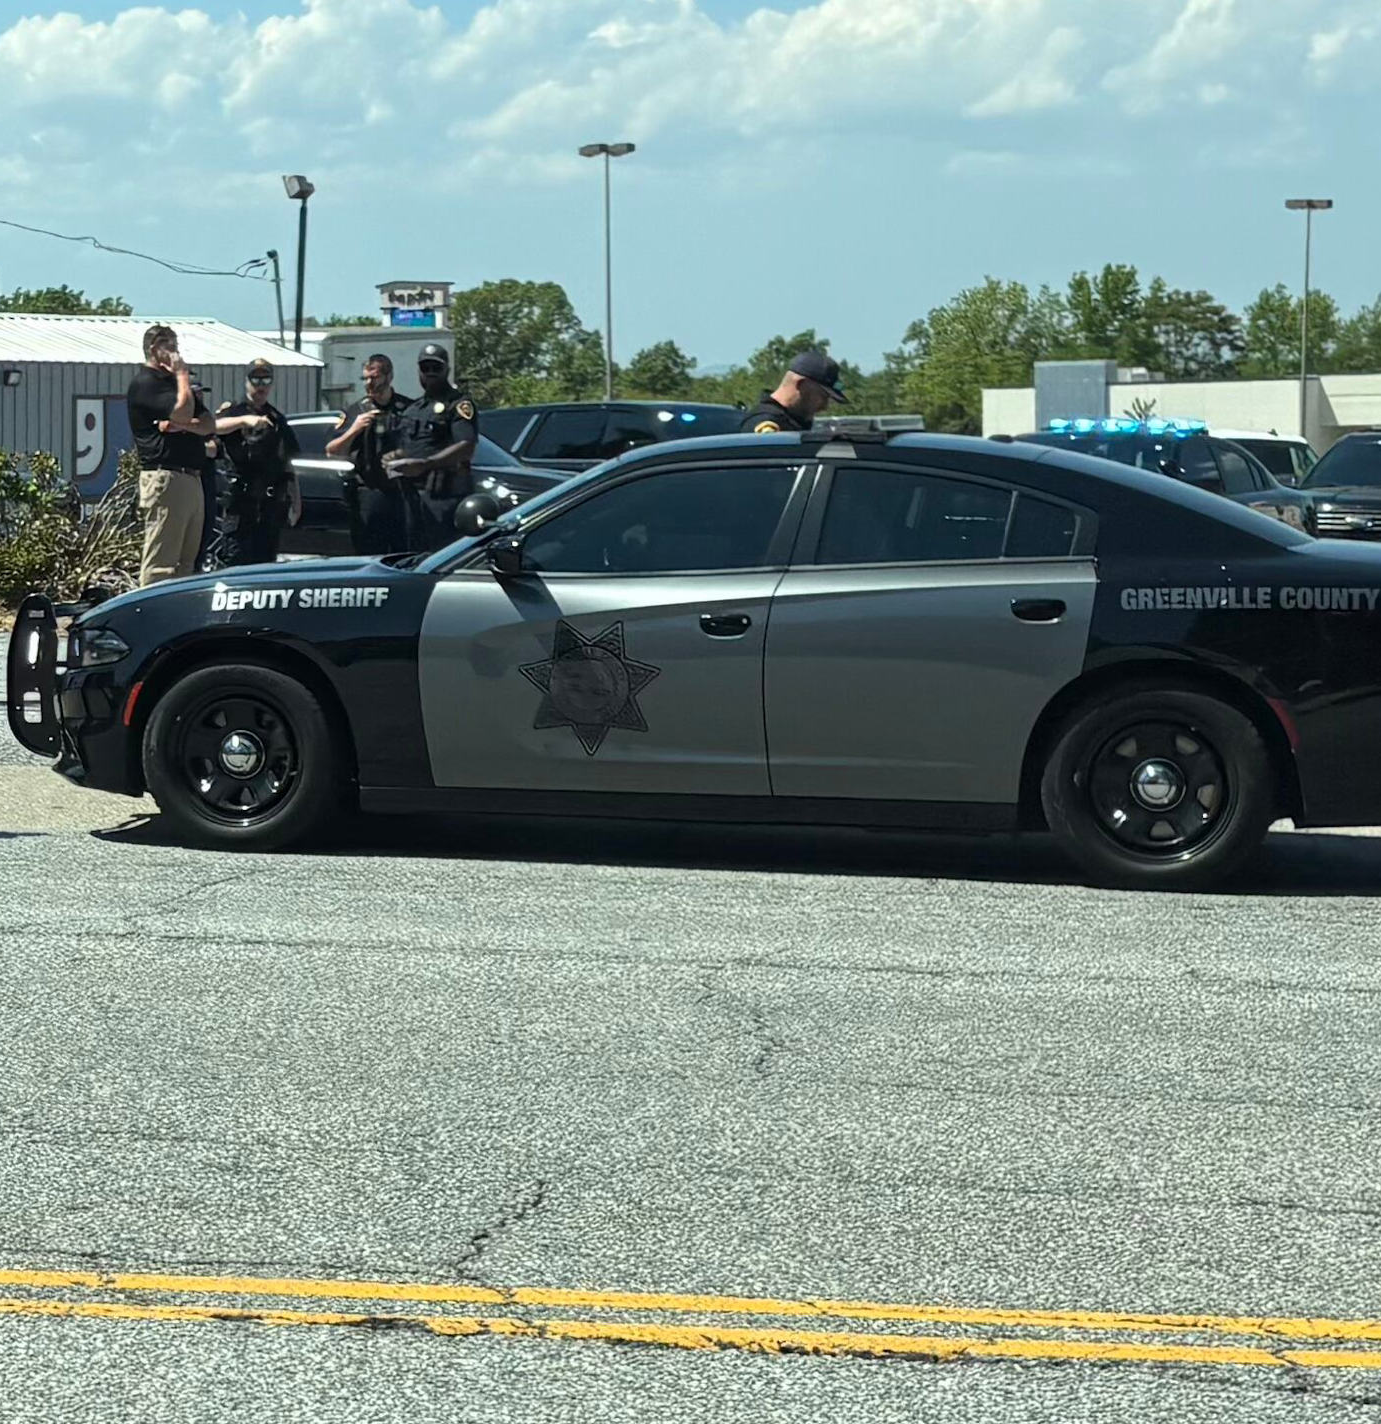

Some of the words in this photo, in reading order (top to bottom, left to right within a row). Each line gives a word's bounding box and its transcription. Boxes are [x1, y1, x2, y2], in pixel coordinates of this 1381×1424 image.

[211, 588, 295, 611] DEPUTY
[298, 587, 389, 608] SHERIFF
[1120, 587, 1272, 610] GREENVILLE
[1279, 586, 1381, 610] COUNTY
